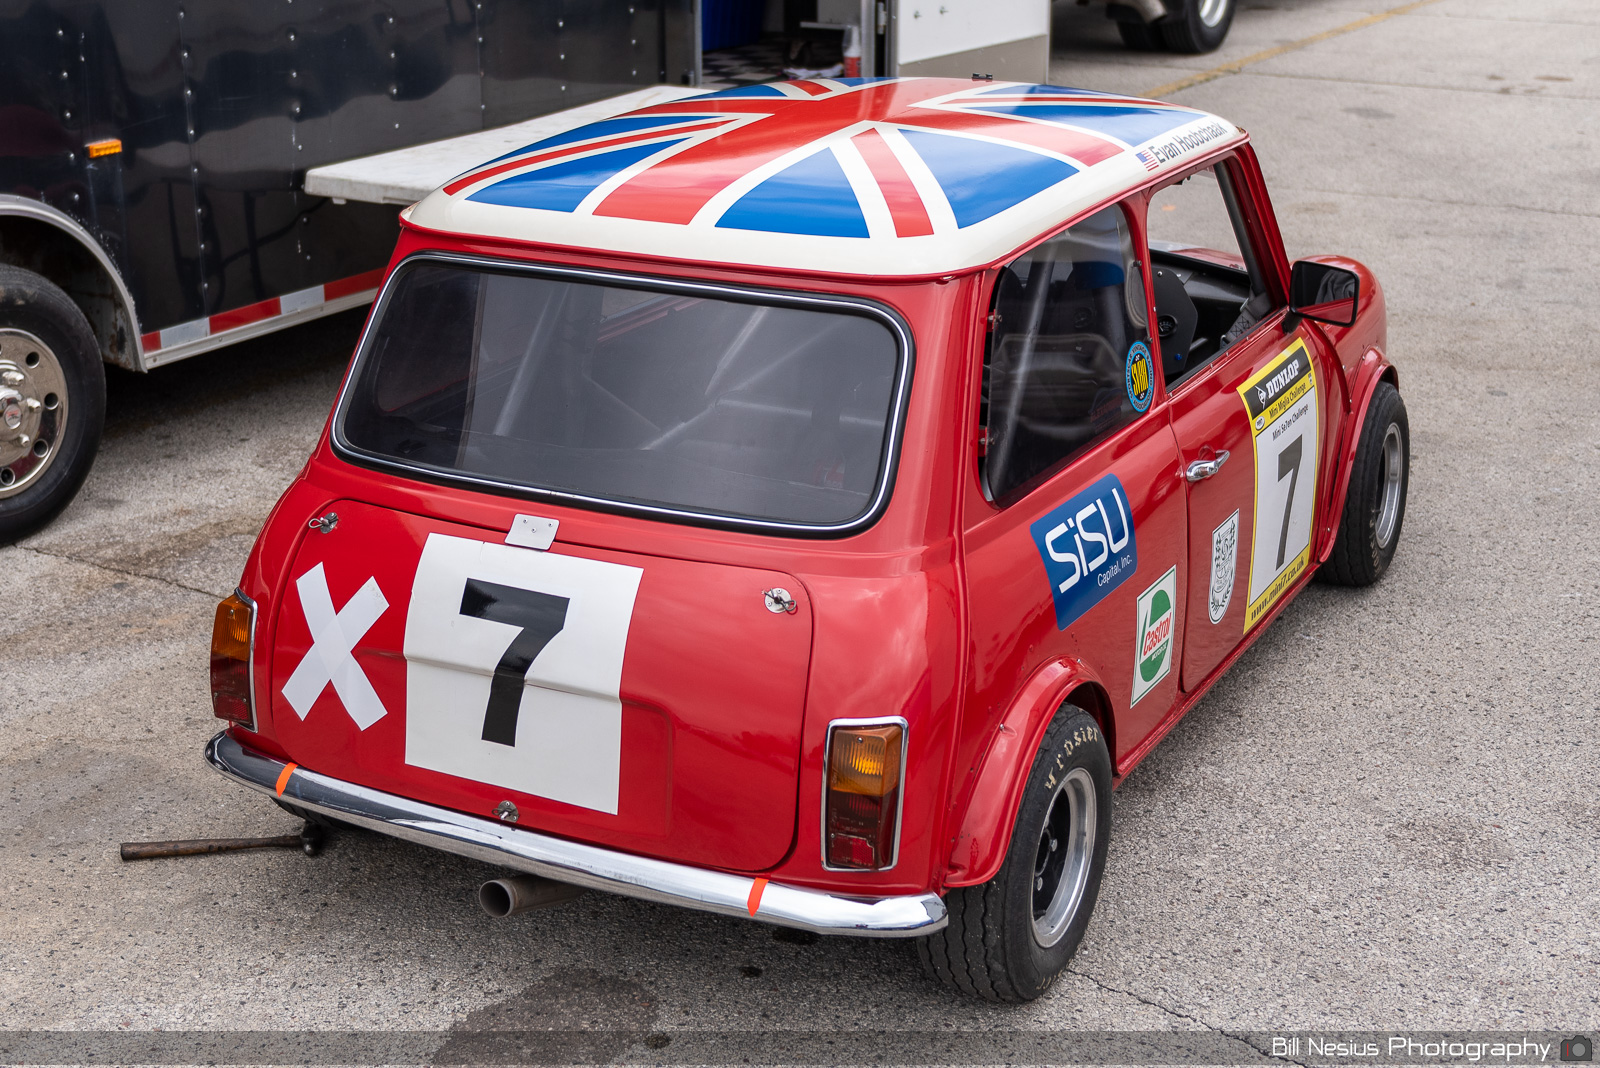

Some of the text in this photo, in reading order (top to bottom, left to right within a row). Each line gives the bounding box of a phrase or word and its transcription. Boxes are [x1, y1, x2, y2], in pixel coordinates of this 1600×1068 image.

[1147, 121, 1228, 164] Evan Hoobchaak
[1131, 358, 1149, 396] SVRA
[1266, 359, 1300, 399] DUNLOP
[1269, 382, 1306, 419] Mini Miglia Challenge
[1272, 425, 1281, 441] Mini
[1291, 403, 1309, 423] Challenge
[1276, 433, 1302, 571] 7
[1097, 554, 1133, 587] Capital, Inc.
[1251, 556, 1305, 621] www.mini7.co.uk
[1143, 612, 1172, 657] Castrol
[460, 578, 570, 747] 7
